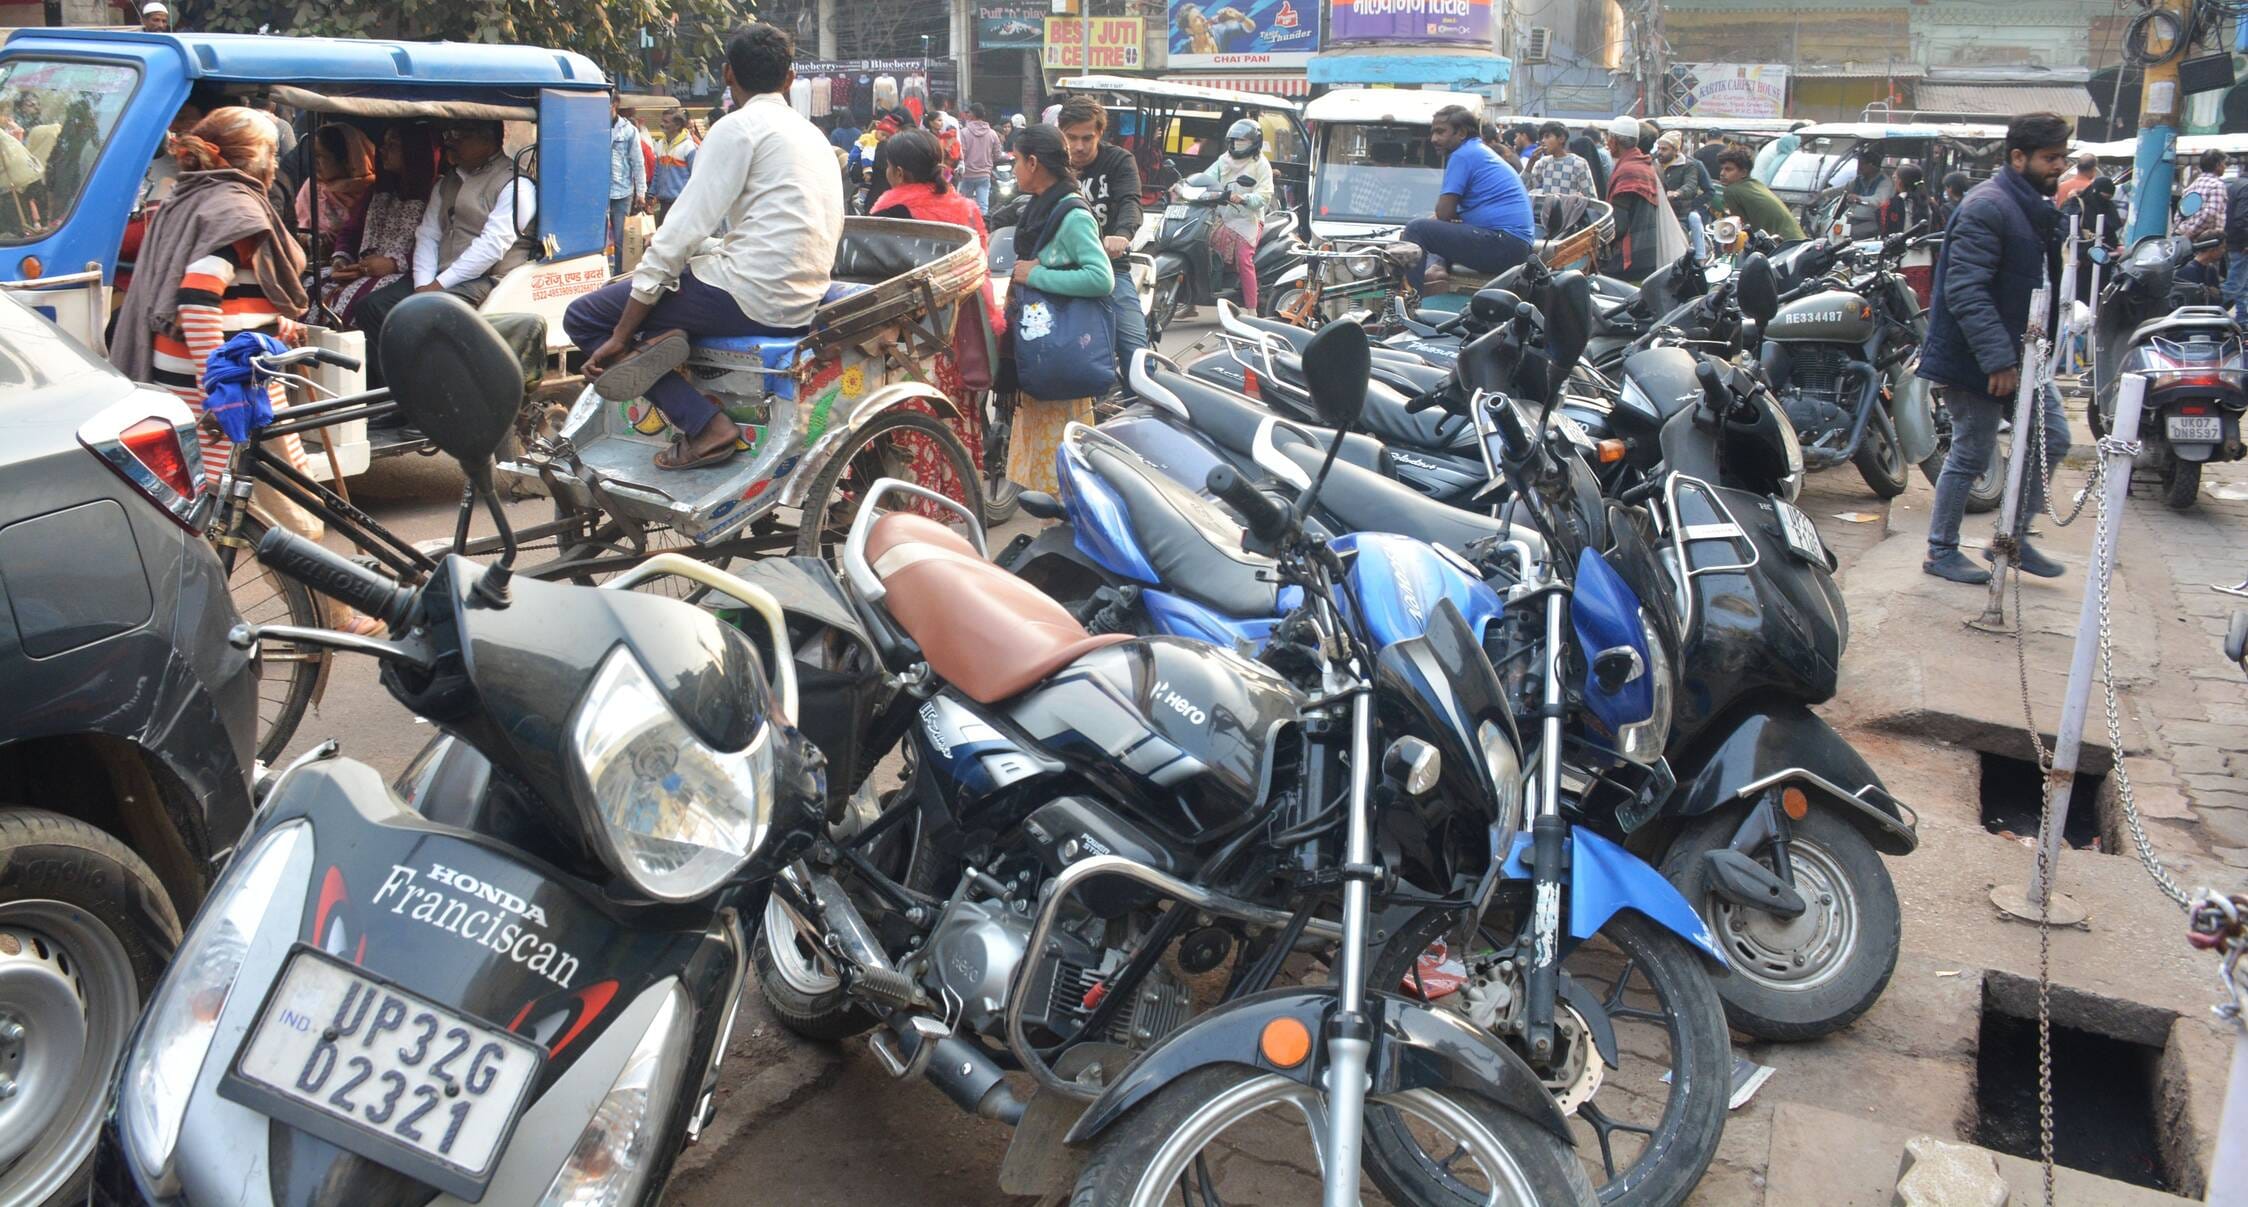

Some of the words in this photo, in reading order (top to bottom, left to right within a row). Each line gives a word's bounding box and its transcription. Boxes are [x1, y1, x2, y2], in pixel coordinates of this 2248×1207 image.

[1023, 8, 1047, 22] play
[1098, 22, 1137, 44] JUTI
[1271, 30, 1313, 42] Thunder
[870, 59, 920, 70] Blueberry
[1214, 55, 1241, 63] CHAI
[1244, 55, 1270, 63] PANI
[1699, 79, 1727, 98] KARTIK
[1757, 80, 1782, 98] HOUSE
[1785, 311, 1843, 324] RE334487
[2181, 418, 2211, 428] UK07
[2174, 428, 2219, 439] DN8597
[1163, 690, 1206, 725] Hero
[426, 863, 548, 928] HONDA
[372, 864, 580, 989] Franciscan
[278, 1008, 312, 1031] IND
[332, 980, 505, 1096] UP32G
[295, 1039, 472, 1155] D2321
